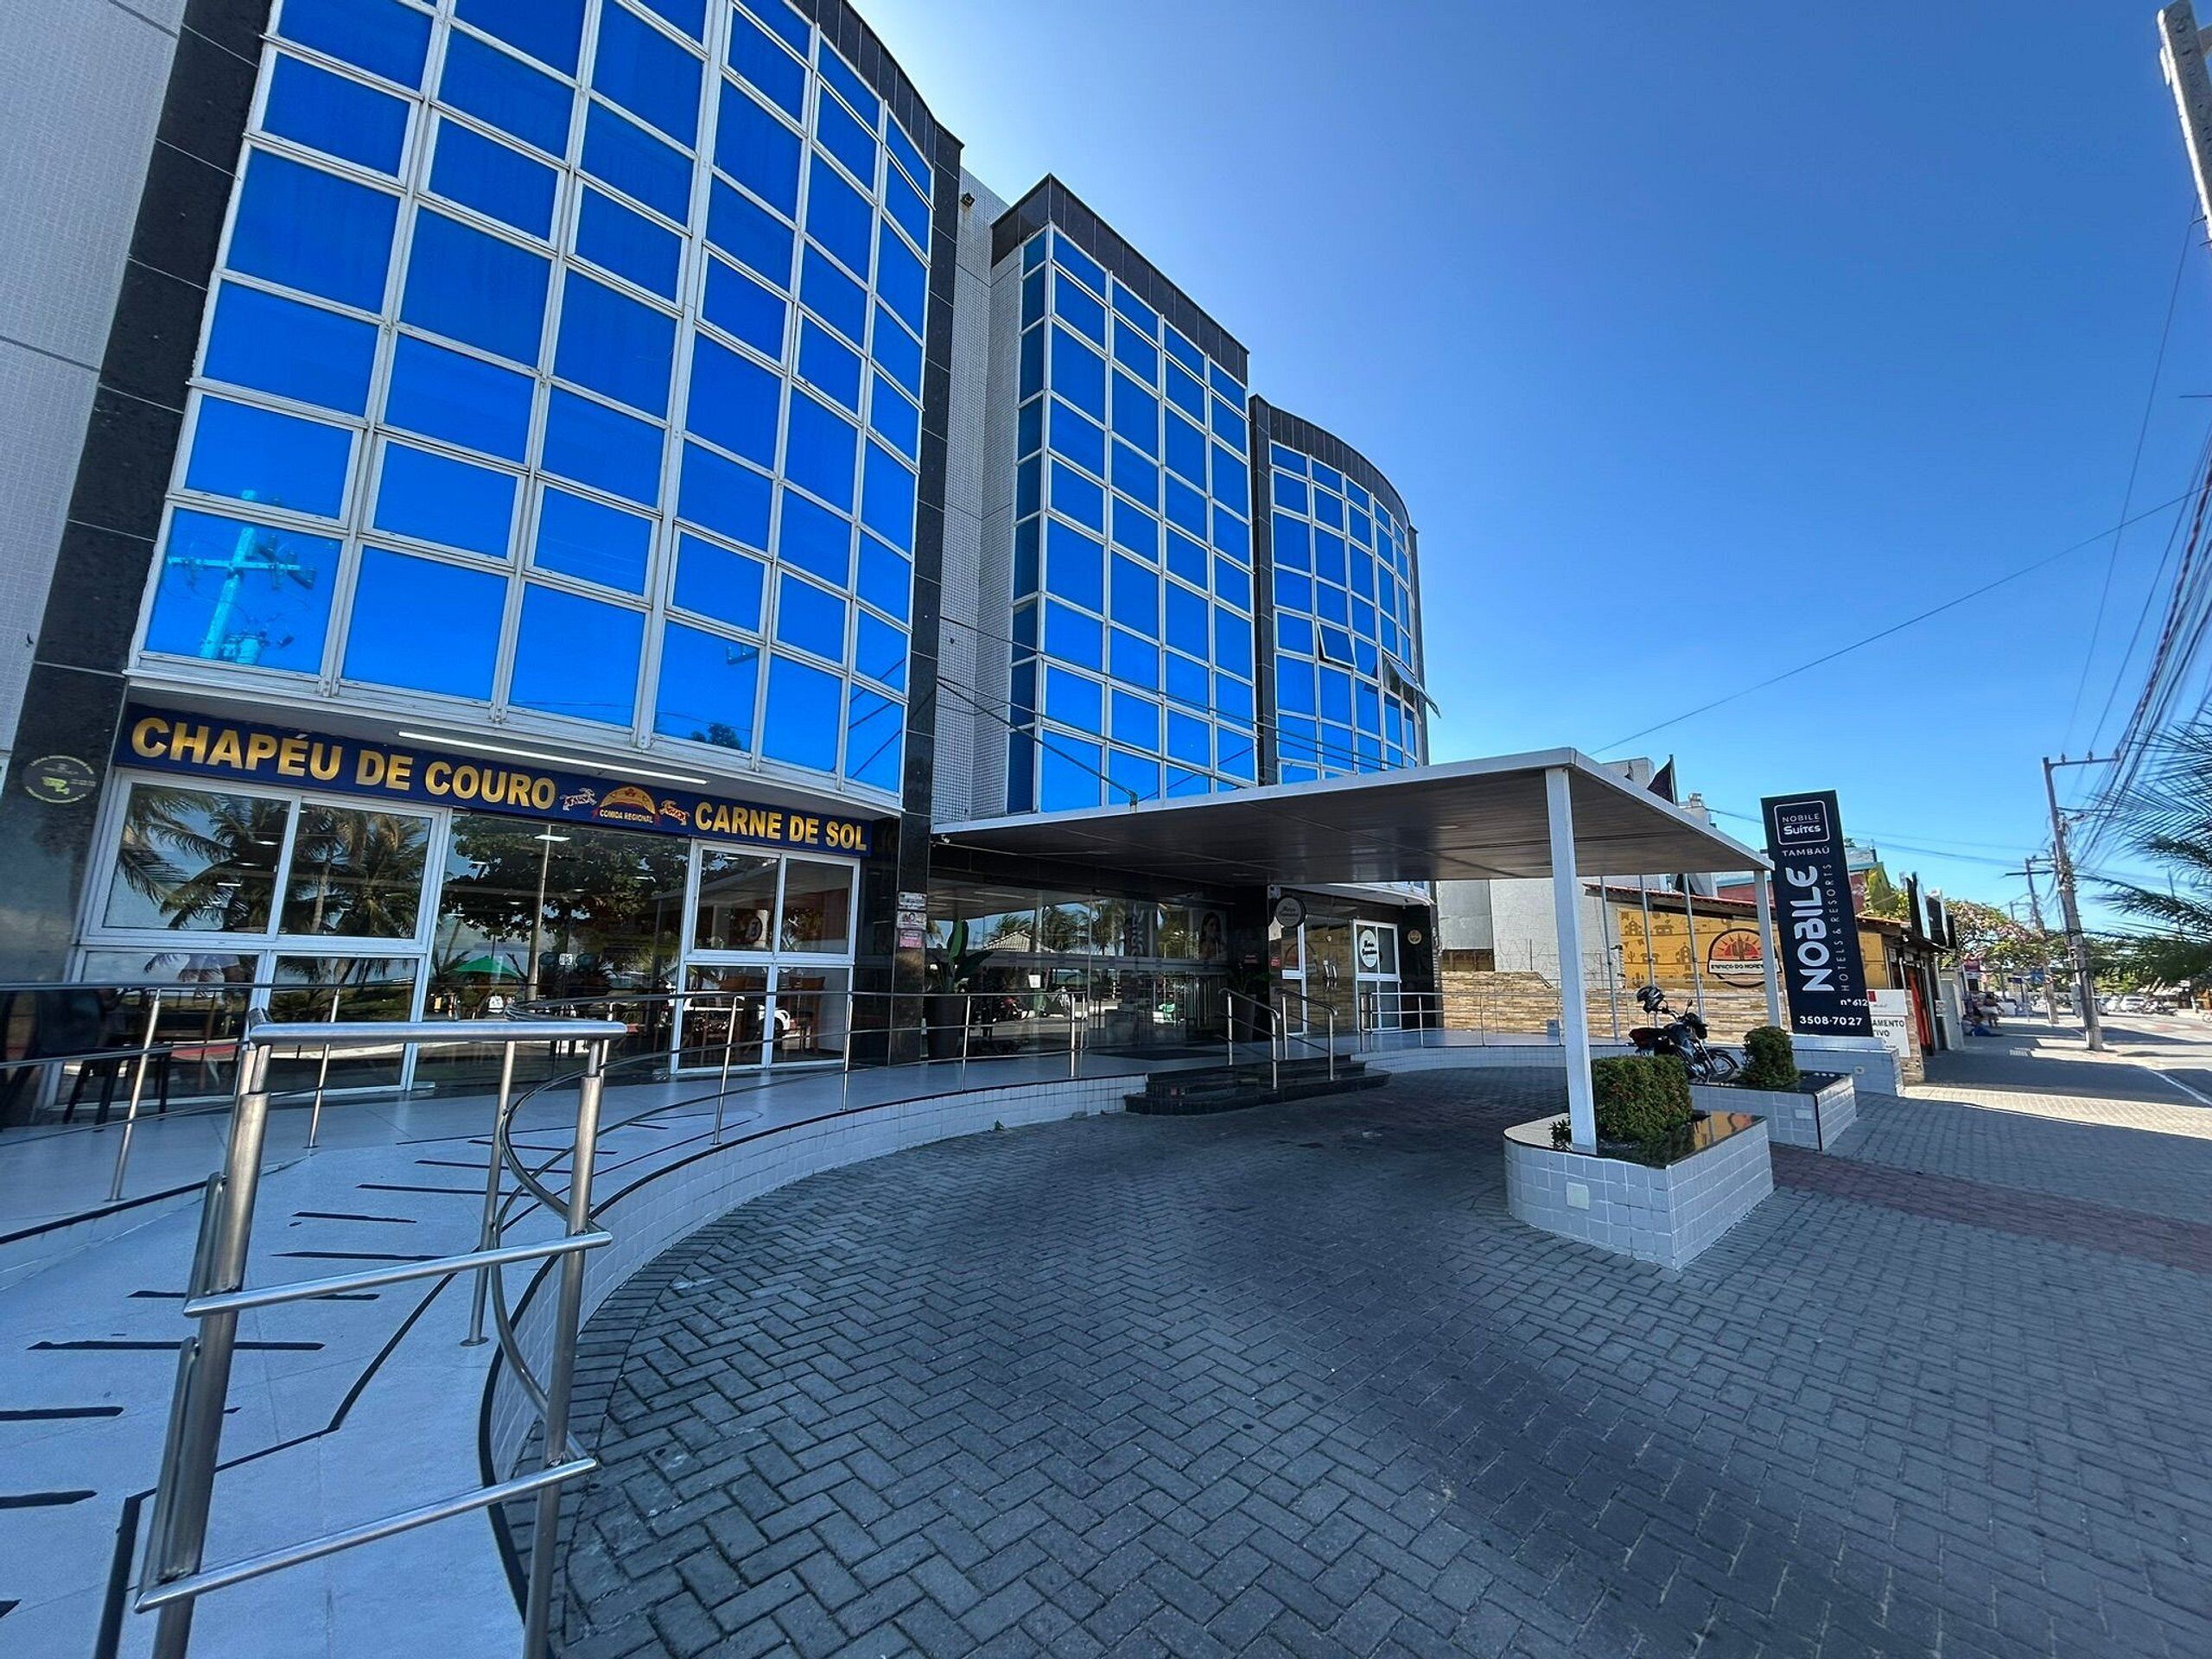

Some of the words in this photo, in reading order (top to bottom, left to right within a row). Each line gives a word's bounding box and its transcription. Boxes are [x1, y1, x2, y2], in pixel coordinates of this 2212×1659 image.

[131, 717, 341, 781] CHAPÉU
[355, 750, 413, 791] DE
[424, 761, 556, 810] COURO
[600, 809, 623, 820] COMIDA
[624, 812, 653, 823] REGIONAL
[695, 802, 781, 839] CARNE
[789, 816, 818, 844] DE
[826, 821, 867, 851] SOL
[1782, 813, 1821, 823] NOBILE
[1781, 845, 1830, 857] TAMBAÚ
[1822, 864, 1840, 922] RESORTS
[1785, 866, 1835, 992] NOBILE
[1834, 940, 1850, 992] HOTELS
